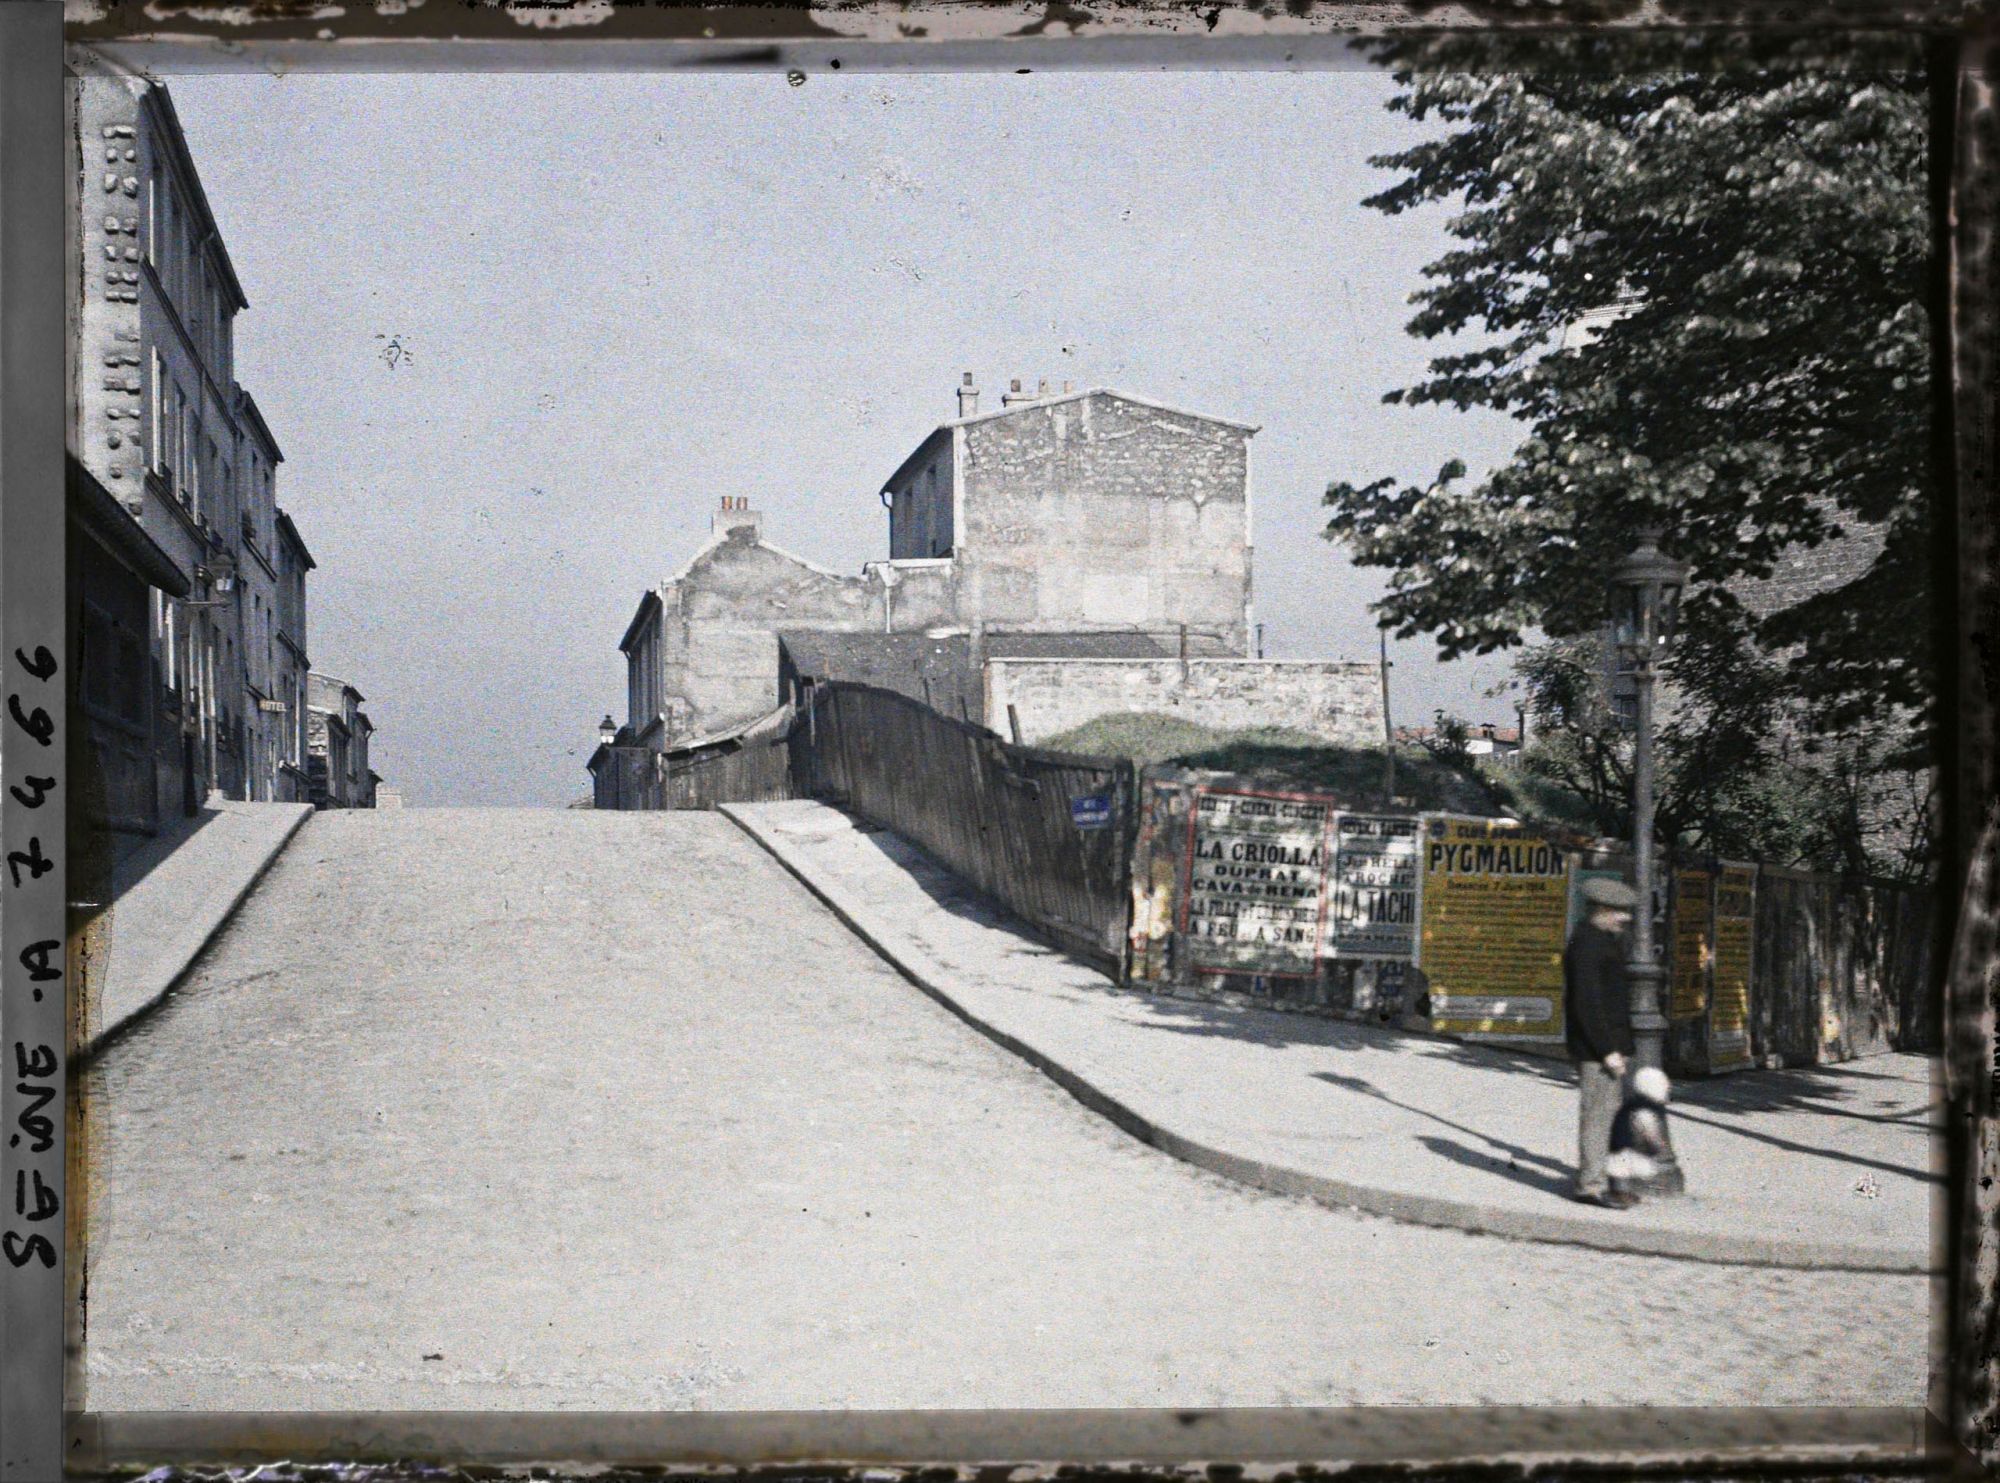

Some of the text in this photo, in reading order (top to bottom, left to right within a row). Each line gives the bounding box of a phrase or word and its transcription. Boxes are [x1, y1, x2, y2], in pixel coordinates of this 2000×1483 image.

[7, 646, 57, 888] 7466
[1196, 839, 1223, 859] LA
[1232, 843, 1320, 867] CRIOLLA
[1430, 843, 1563, 875] PYGMALION
[1193, 880, 1242, 893] CAVA
[1215, 865, 1298, 881] DUPRAT
